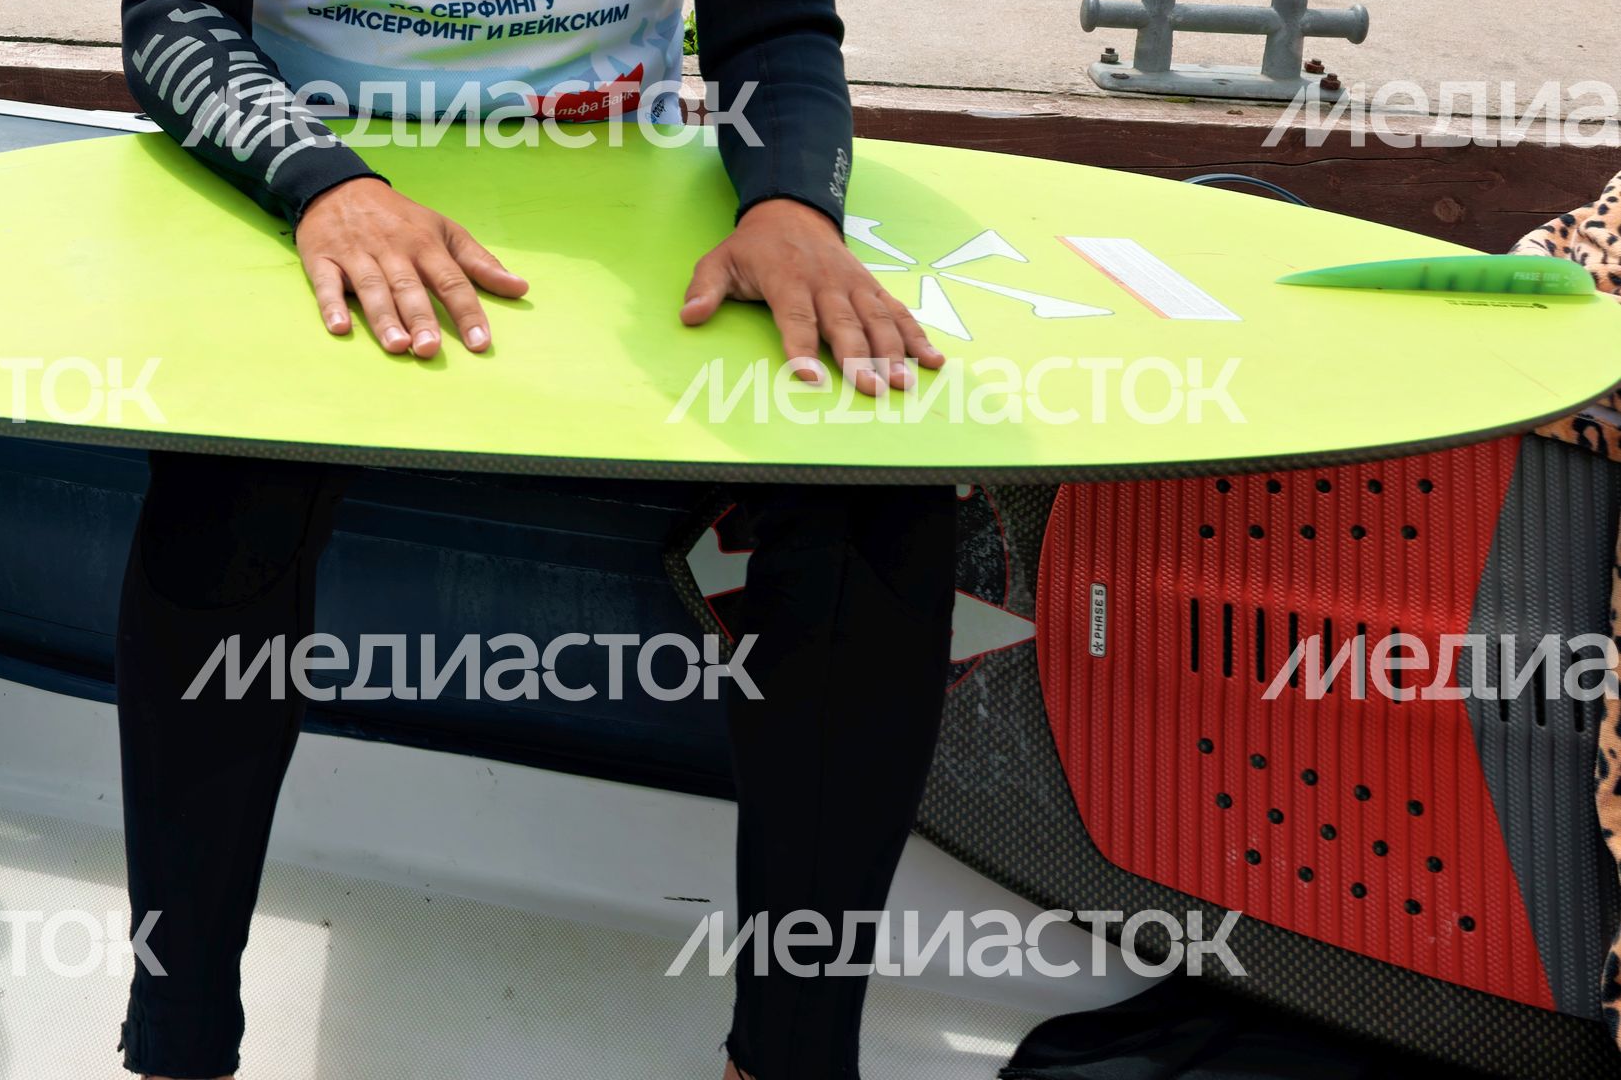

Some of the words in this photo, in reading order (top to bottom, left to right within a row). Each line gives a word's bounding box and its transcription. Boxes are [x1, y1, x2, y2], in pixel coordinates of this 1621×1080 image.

[486, 24, 503, 41] И
[507, 3, 630, 38] ВЕЙКСКИМ
[1094, 599, 1104, 639] PHASE
